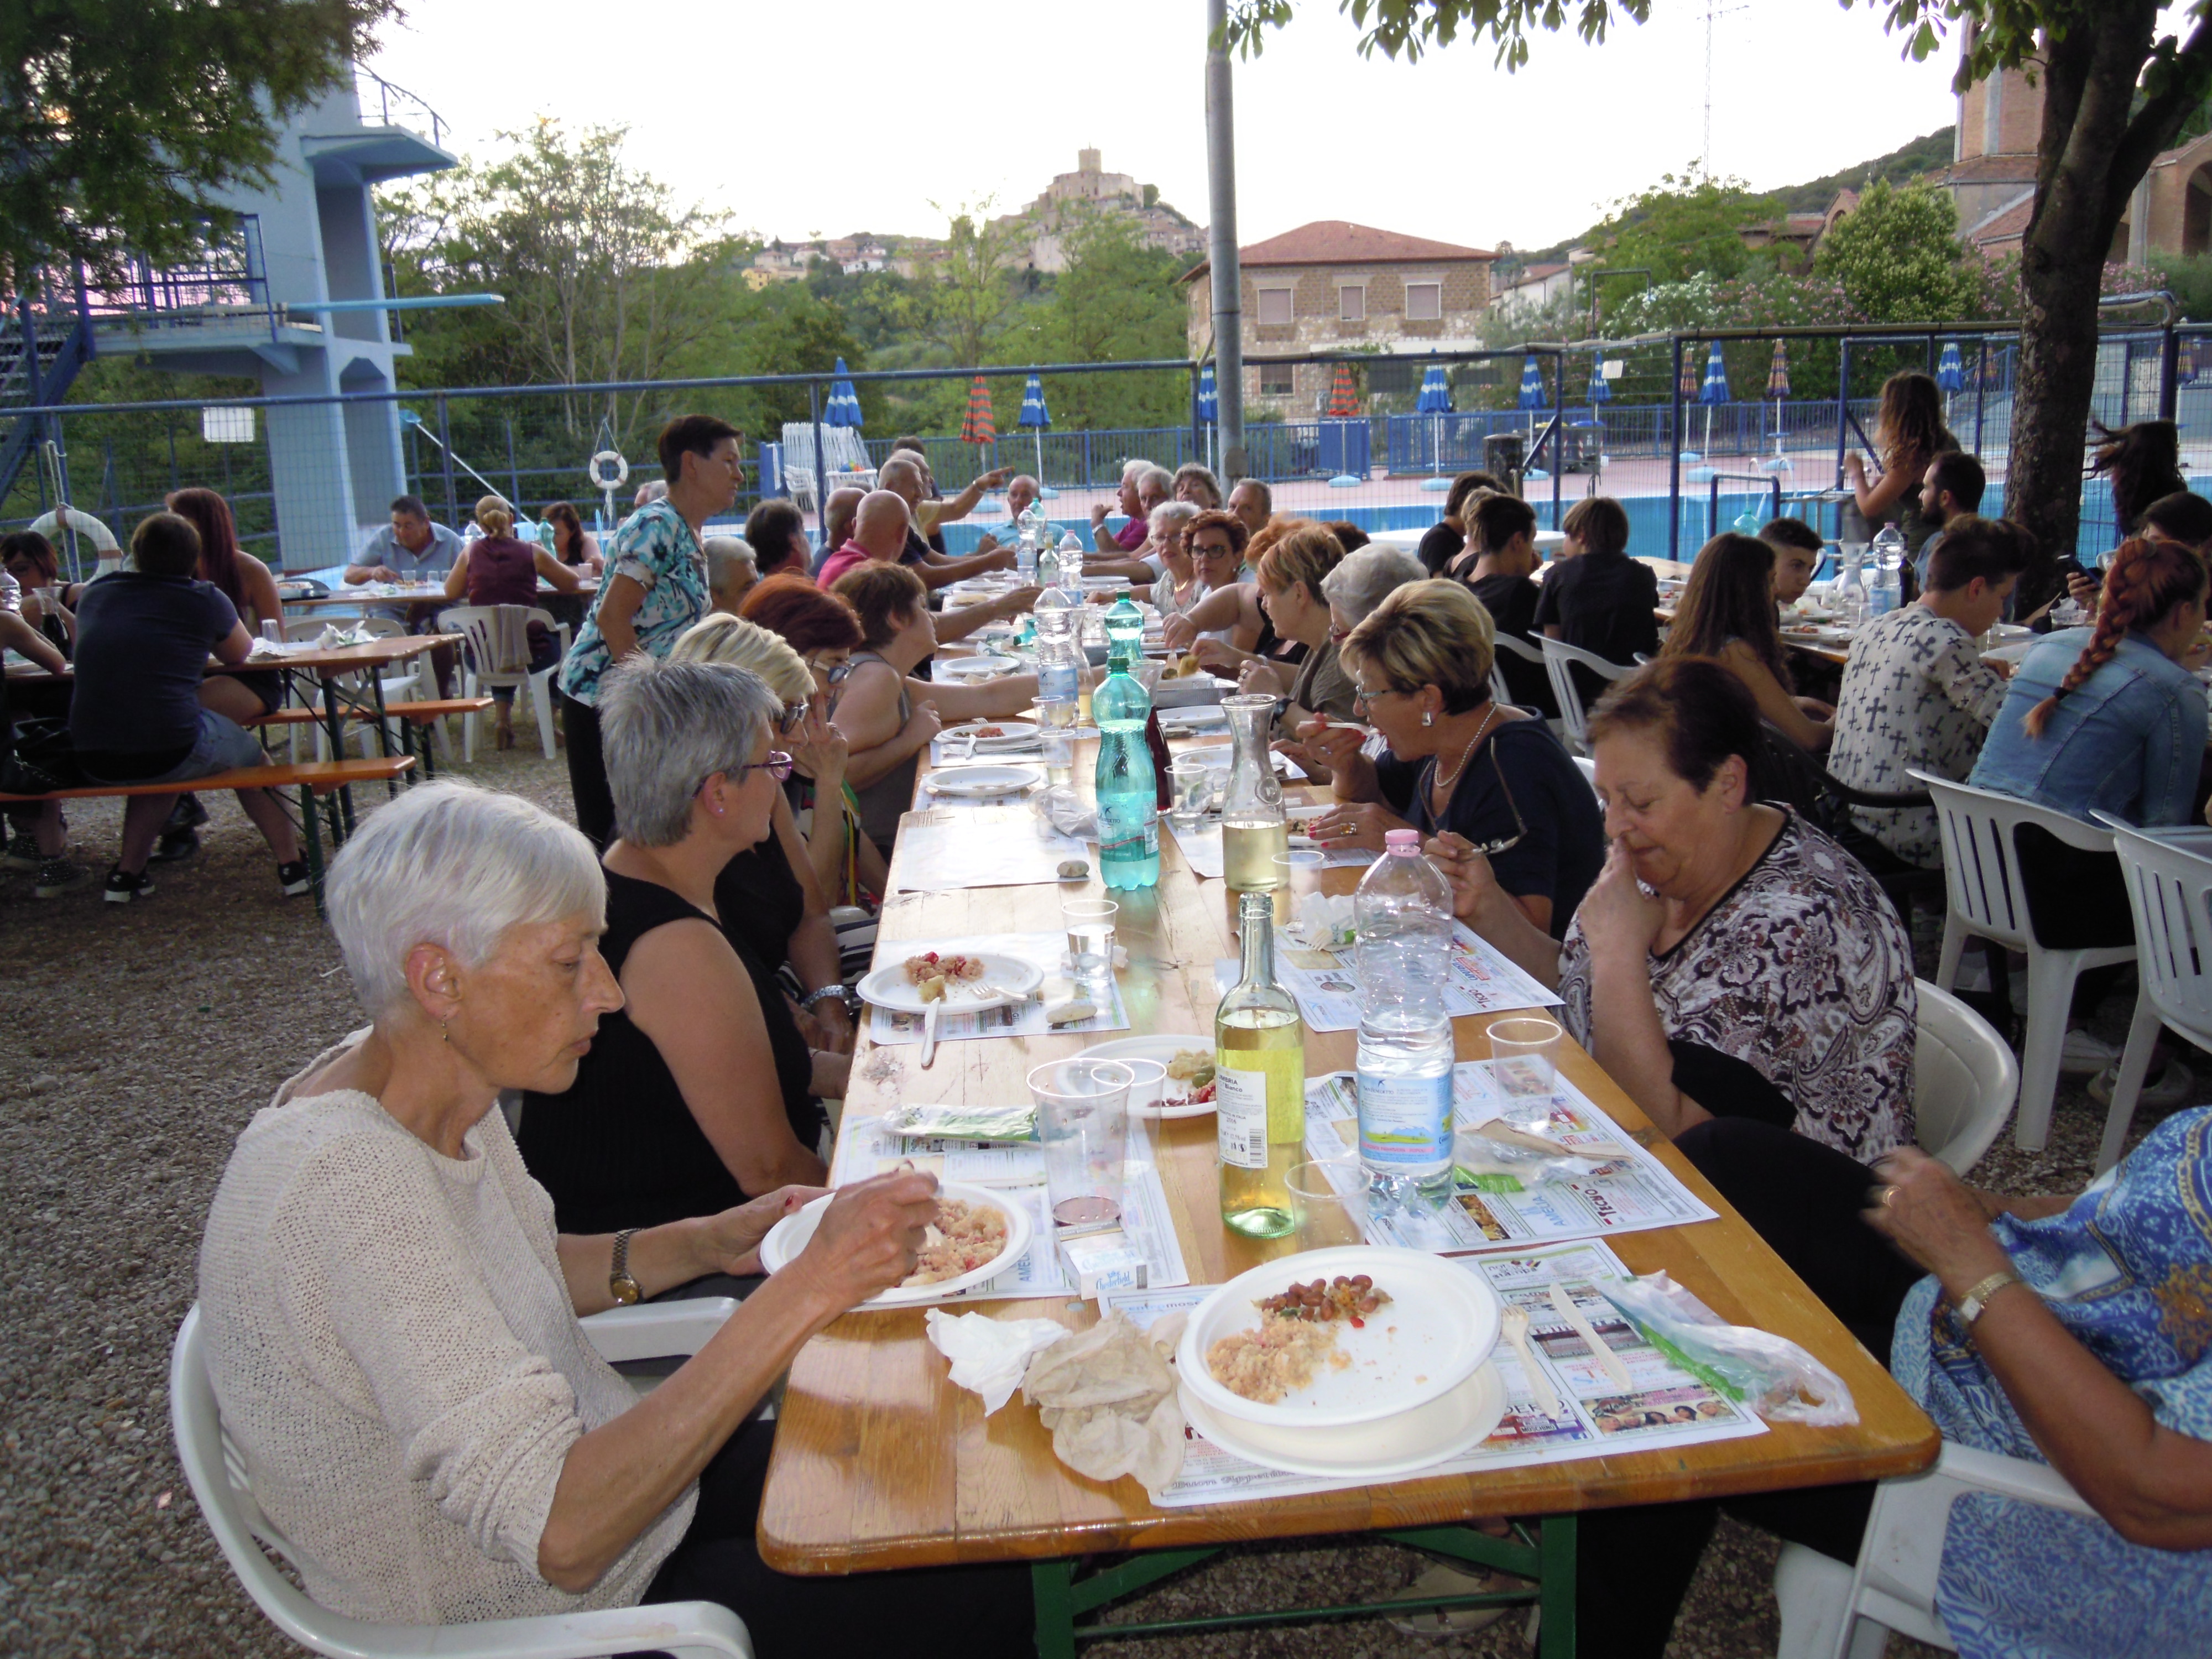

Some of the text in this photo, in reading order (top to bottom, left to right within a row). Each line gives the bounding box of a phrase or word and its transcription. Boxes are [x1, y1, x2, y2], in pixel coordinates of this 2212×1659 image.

[1224, 1083, 1243, 1093] Bianco
[1532, 1196, 1567, 1227] AMELIA
[1584, 1188, 1617, 1217] TECNO
[1018, 1252, 1032, 1282] AMELI
[1095, 1271, 1130, 1290] Chesterfield
